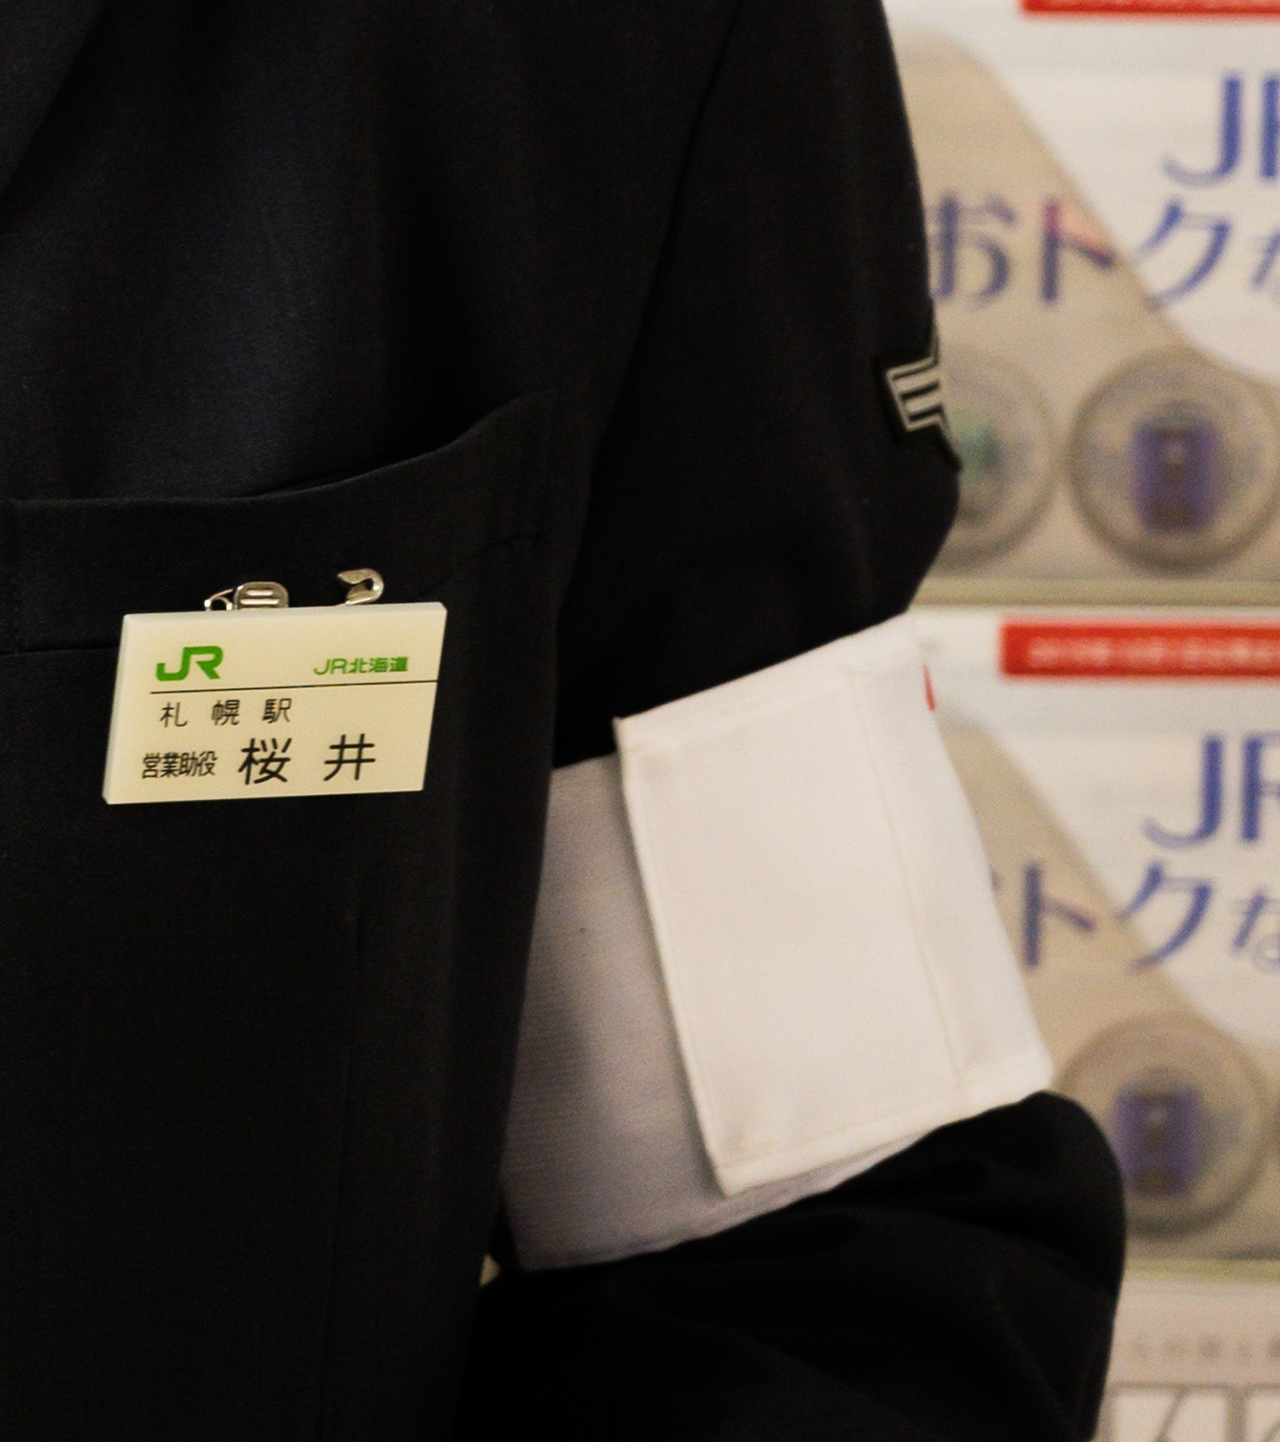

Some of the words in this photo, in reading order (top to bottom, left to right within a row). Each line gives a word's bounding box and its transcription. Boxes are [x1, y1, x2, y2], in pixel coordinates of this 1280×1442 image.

[155, 645, 224, 682] JR
[313, 656, 408, 676] JR北海道
[141, 751, 219, 780] 営業助役
[238, 733, 376, 785] 桜井
